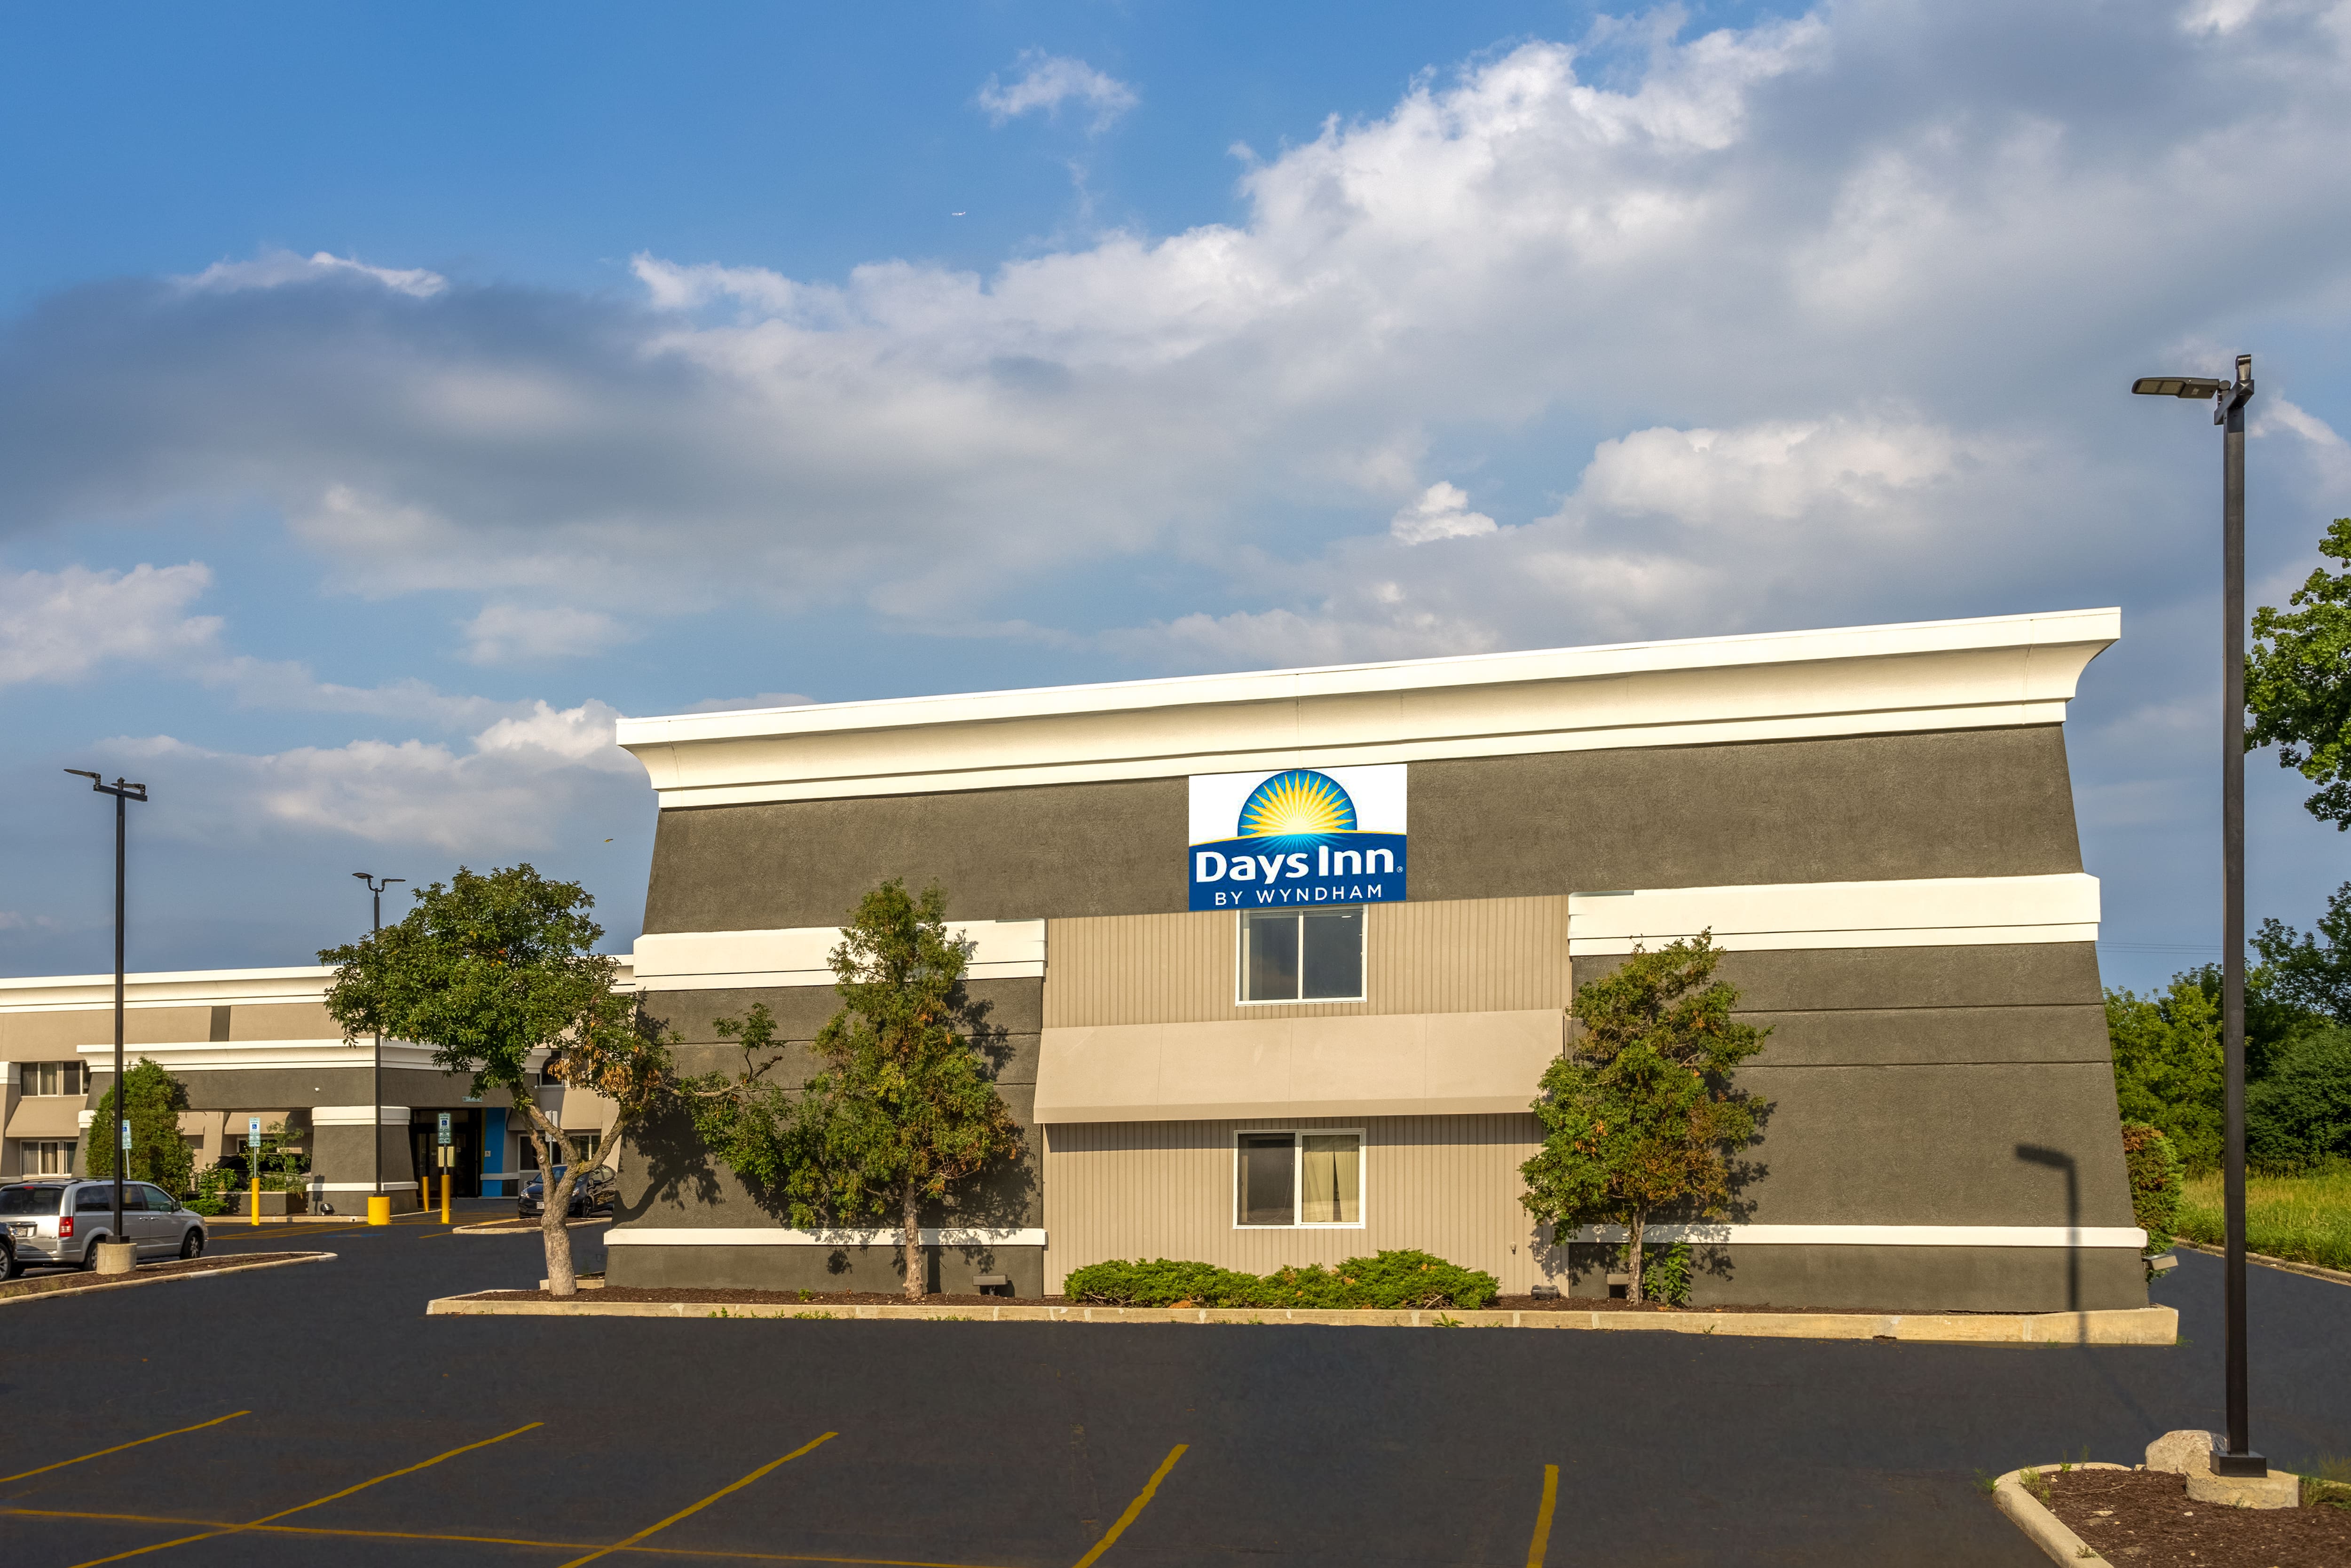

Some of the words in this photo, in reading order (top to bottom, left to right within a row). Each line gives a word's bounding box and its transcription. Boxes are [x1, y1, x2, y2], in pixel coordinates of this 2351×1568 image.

[1196, 851, 1309, 884] Days
[1215, 891, 1243, 906] BY
[1256, 884, 1381, 904] WYNDHAM
